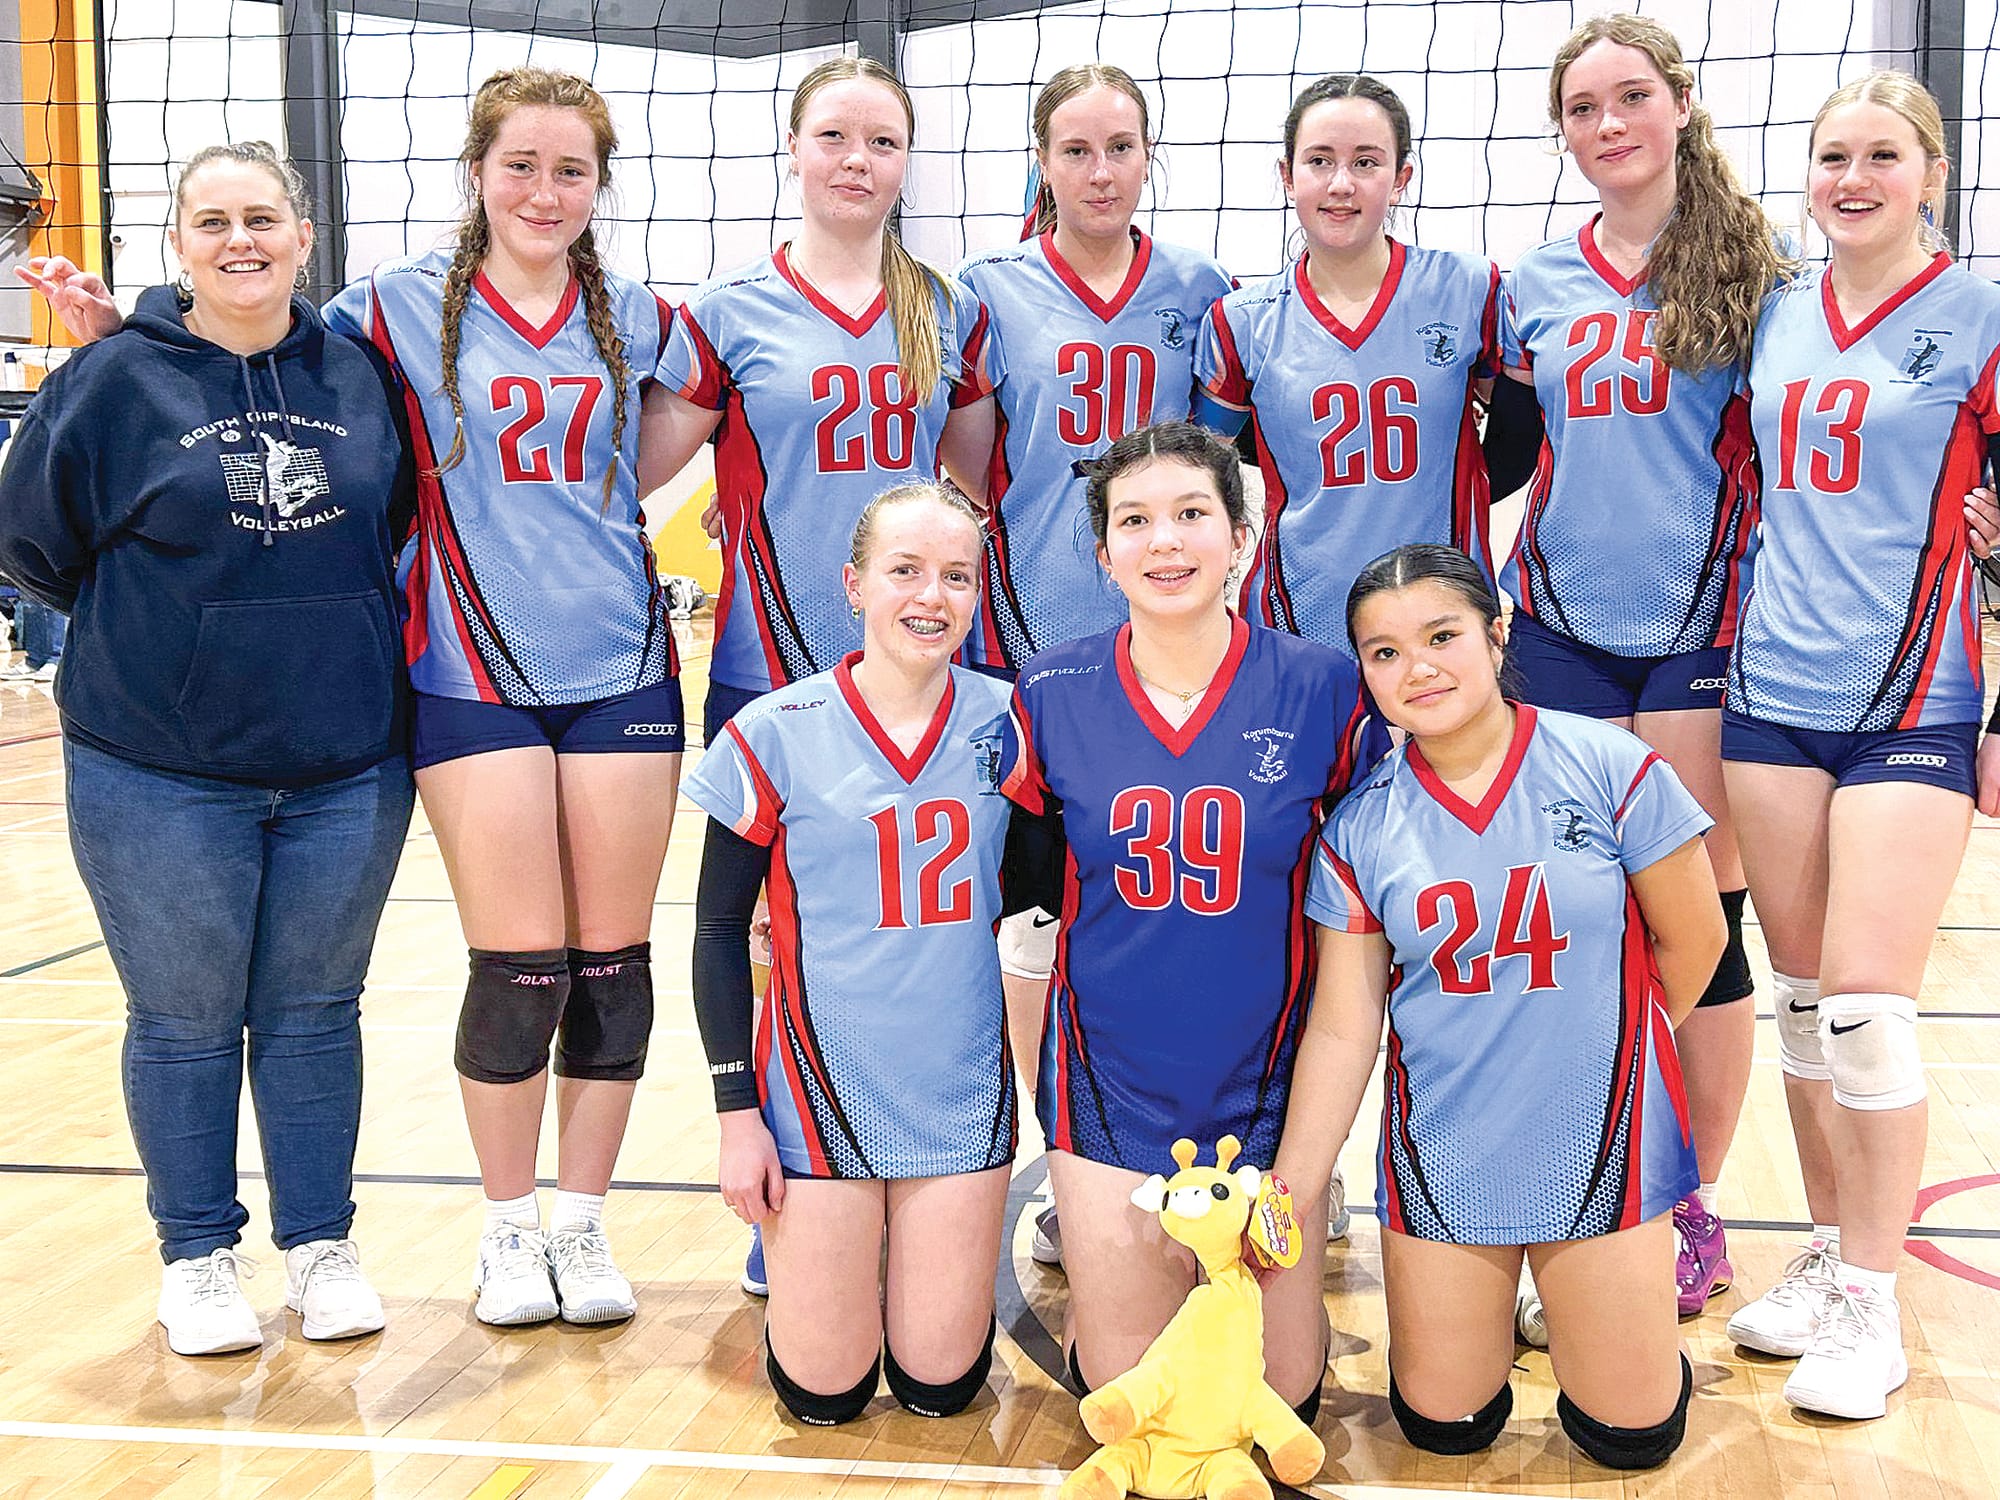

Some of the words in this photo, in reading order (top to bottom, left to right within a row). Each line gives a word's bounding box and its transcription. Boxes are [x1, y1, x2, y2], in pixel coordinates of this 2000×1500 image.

[1055, 340, 1158, 447] 30
[1564, 307, 1672, 420] 25
[179, 417, 240, 449] SOUTH
[490, 375, 604, 483] 27
[809, 362, 919, 474] 28
[1311, 376, 1419, 489] 26
[1771, 375, 1873, 495] 13
[230, 505, 346, 531] VOLLEYBALL
[624, 724, 677, 735] JOUST
[1690, 678, 1728, 689] JOU
[1886, 754, 1948, 768] JOUST
[864, 798, 974, 931] 12
[1110, 786, 1245, 916] 39
[579, 964, 622, 977] JOUST
[1413, 863, 1571, 996] 24
